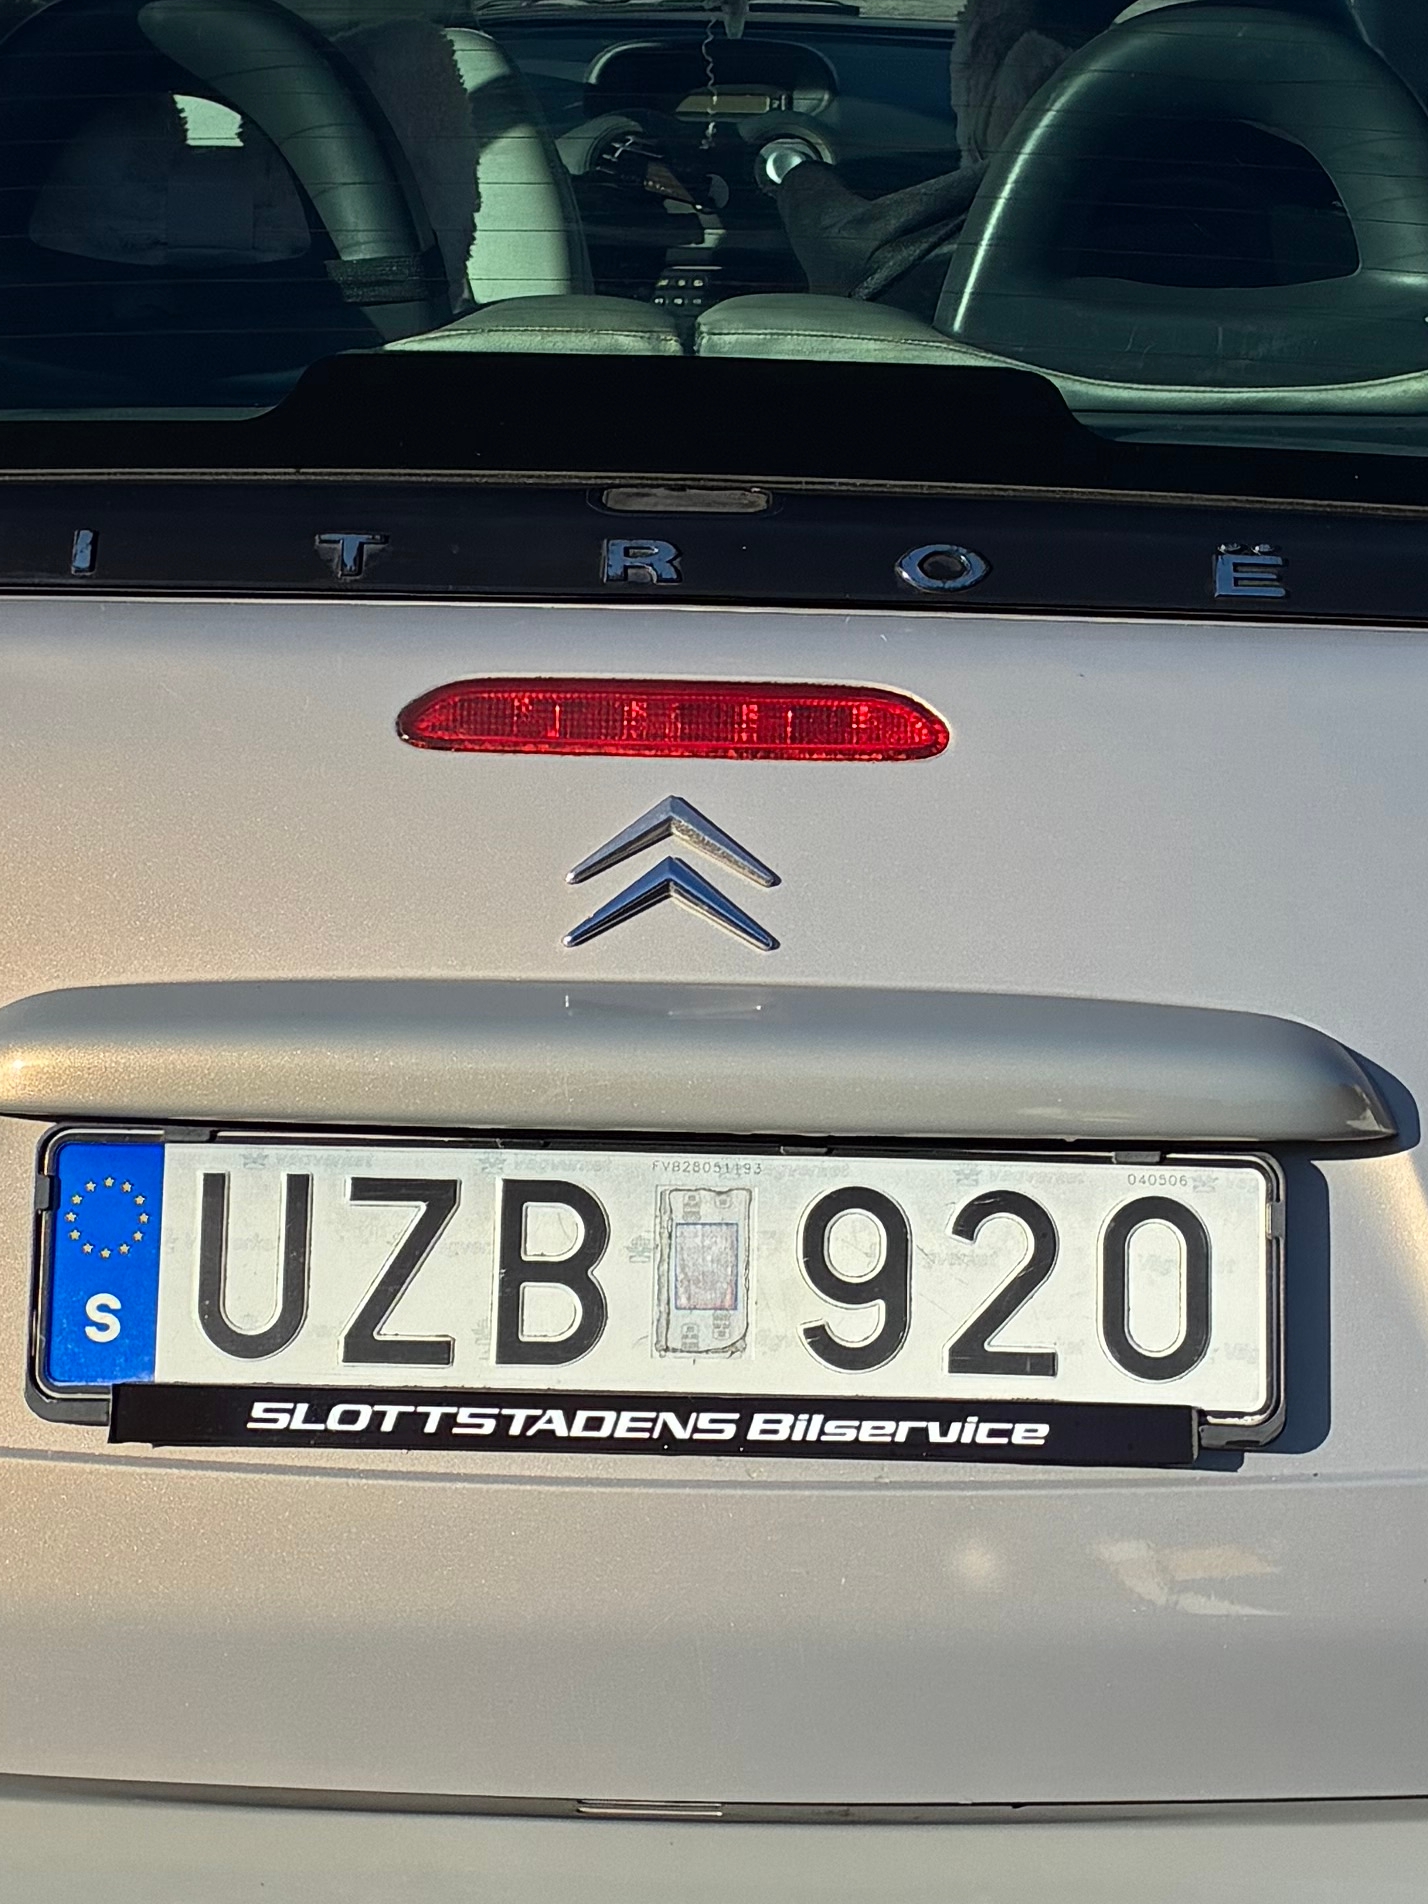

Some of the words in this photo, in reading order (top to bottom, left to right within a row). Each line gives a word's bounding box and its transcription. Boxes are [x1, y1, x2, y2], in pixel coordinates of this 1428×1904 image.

[1127, 1173, 1188, 1187] 040506
[199, 1173, 608, 1366] UZB
[803, 1187, 1210, 1381] 920
[84, 1292, 122, 1343] S
[247, 1402, 741, 1440] SLOTTSTADENS
[746, 1413, 1050, 1445] Bilservice
